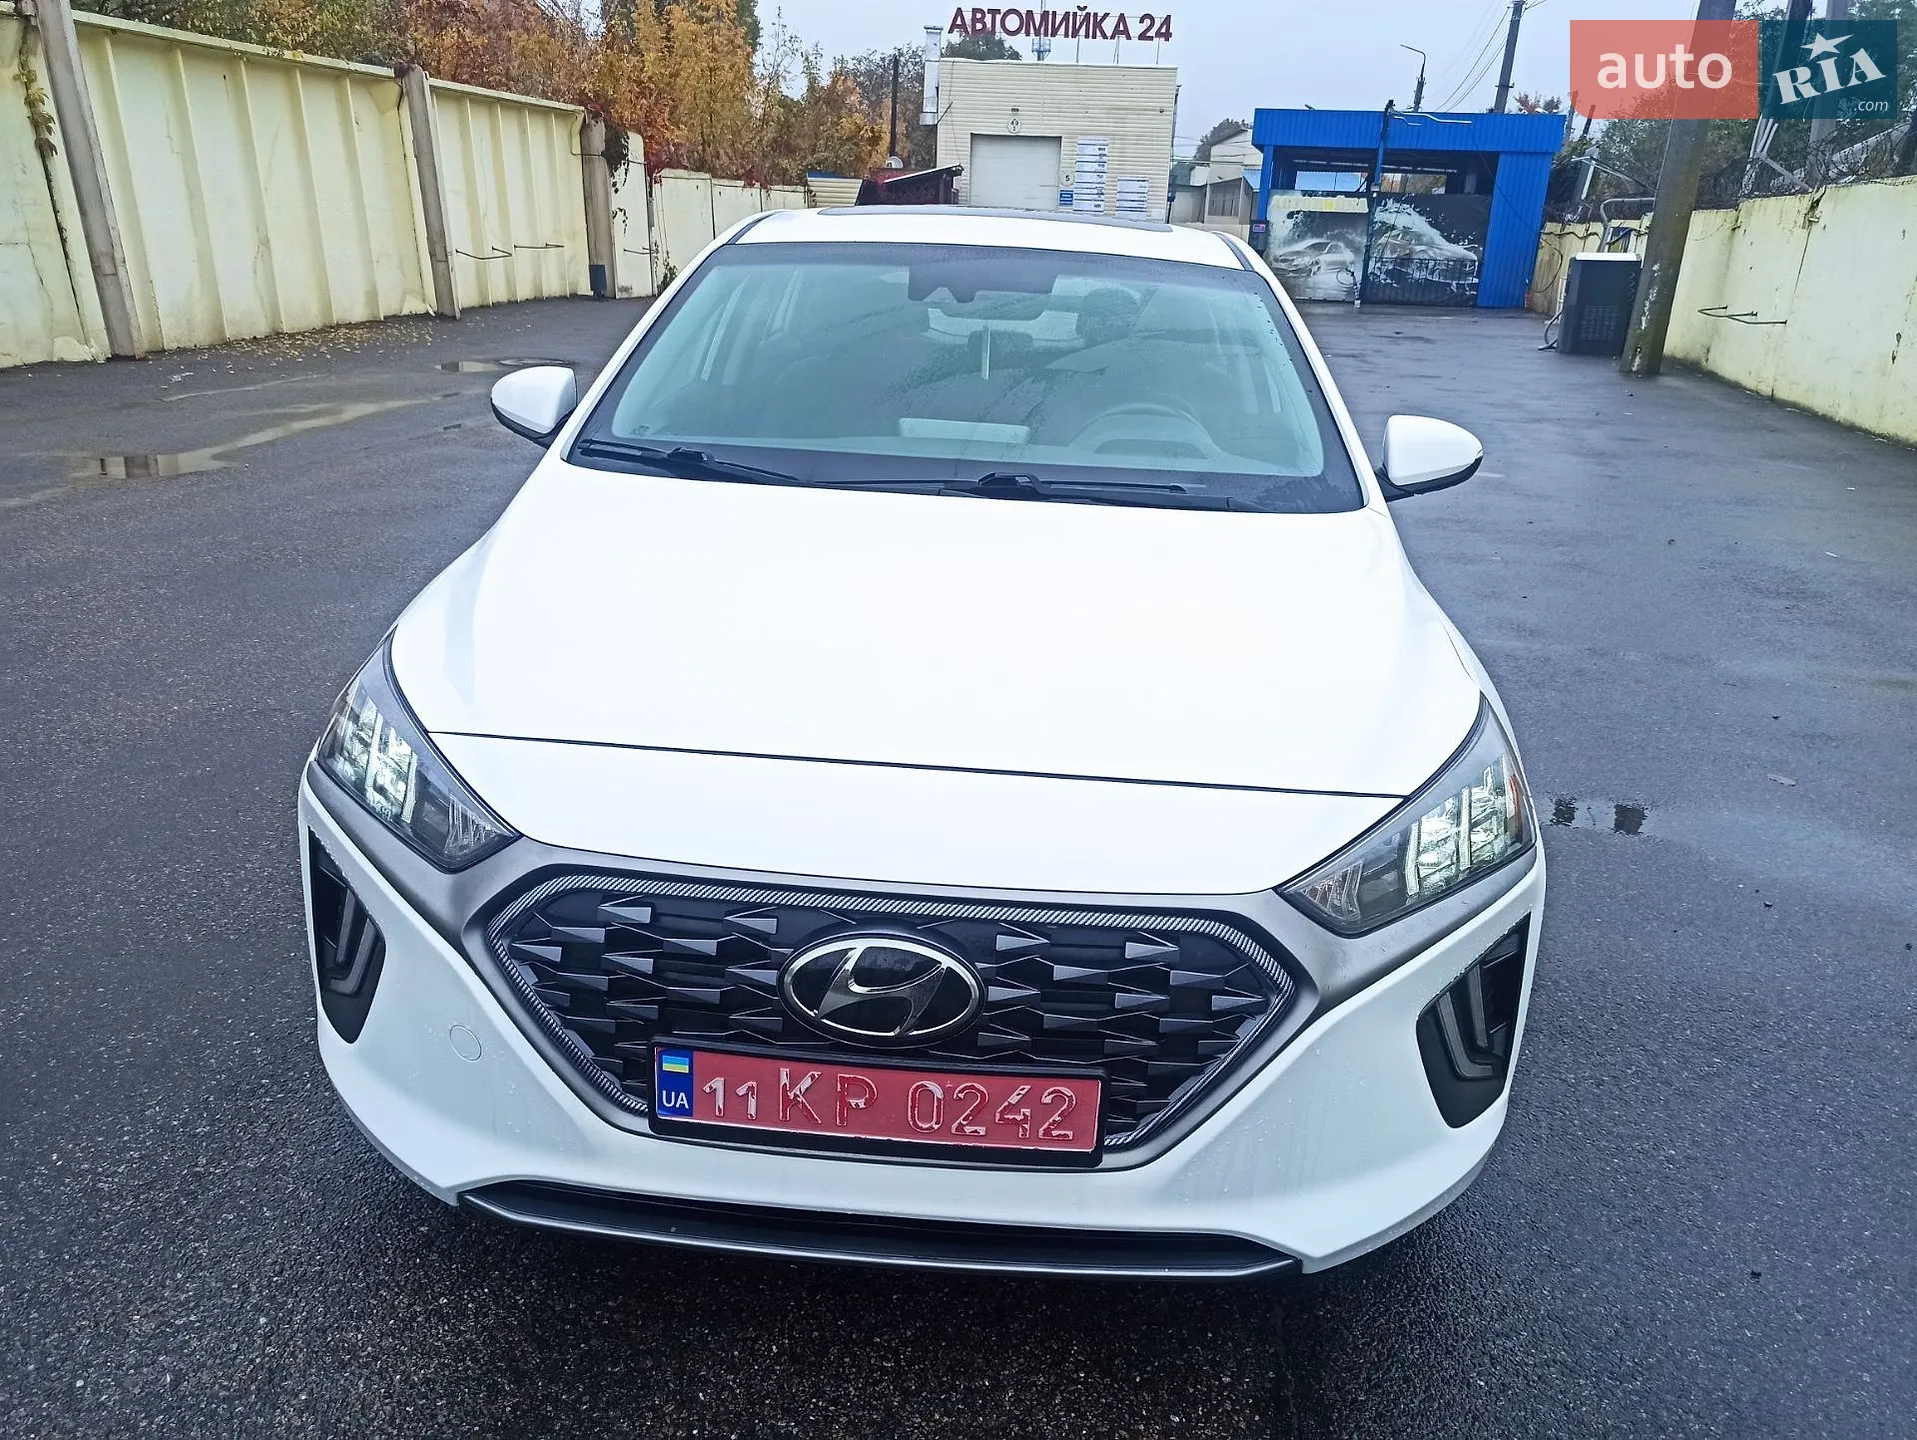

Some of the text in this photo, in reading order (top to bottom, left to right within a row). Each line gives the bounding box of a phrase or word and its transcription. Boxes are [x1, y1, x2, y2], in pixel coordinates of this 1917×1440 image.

[948, 5, 1172, 42] АВТОМИЙКА 24
[662, 1089, 689, 1109] UA
[907, 1080, 1077, 1140] 0242
